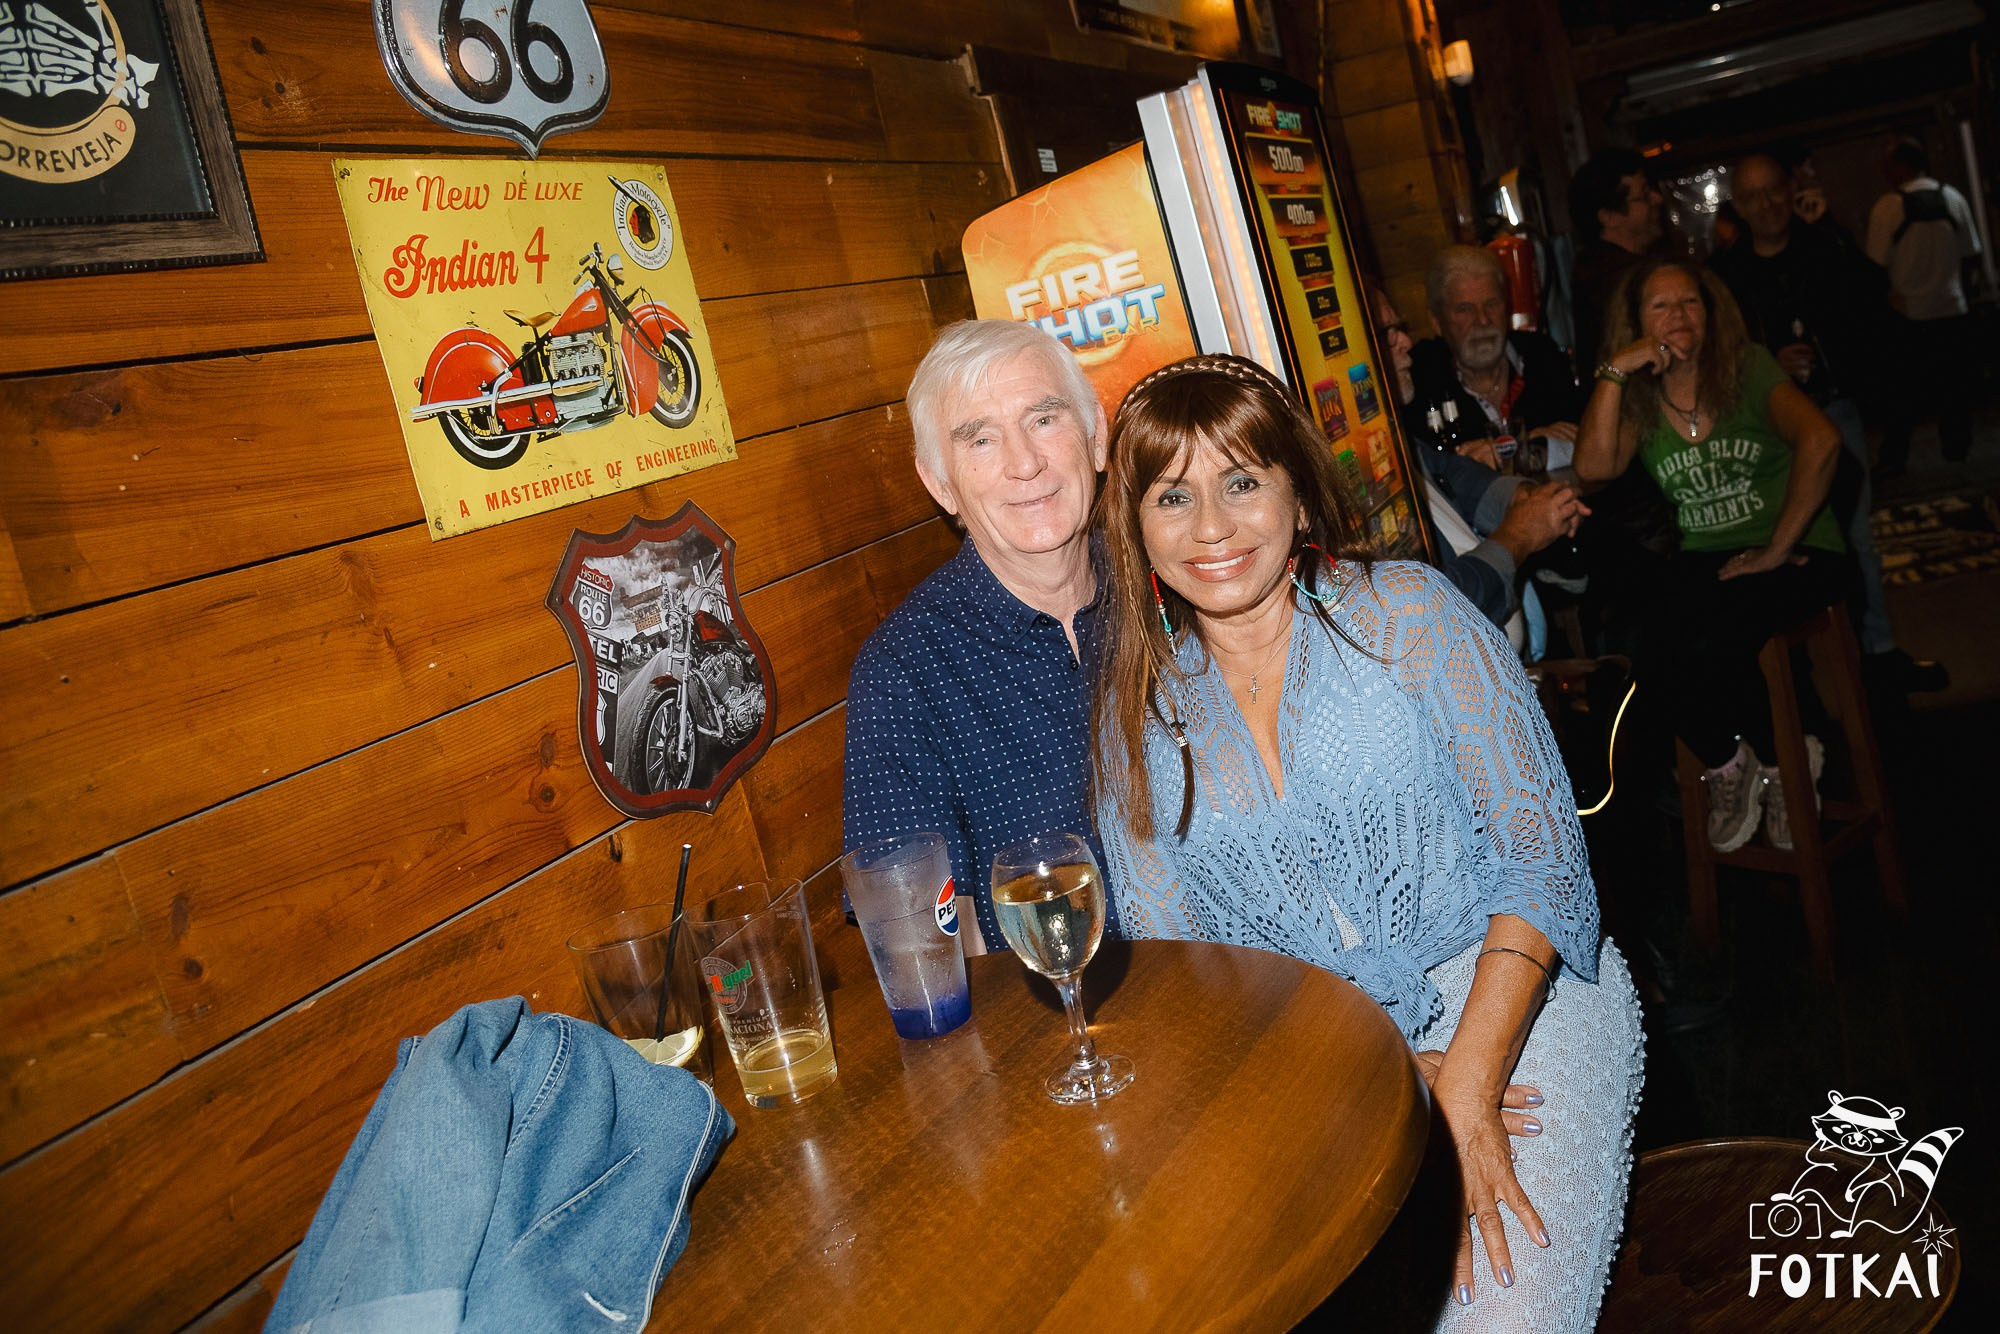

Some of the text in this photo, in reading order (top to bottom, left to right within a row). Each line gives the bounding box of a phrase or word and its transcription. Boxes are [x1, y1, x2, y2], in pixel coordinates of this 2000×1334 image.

[438, 0, 574, 104] 66
[1246, 104, 1302, 129] FIRE SHOT
[0, 131, 122, 173] ORREVIEJA
[368, 175, 583, 211] The New DE LUXE
[384, 226, 550, 299] Indian 4
[1005, 250, 1146, 321] FIRE
[1030, 283, 1166, 347] HOT
[1102, 317, 1160, 346] BAR
[1708, 438, 1763, 463] BLUE
[459, 438, 718, 518] A MASTERPIECE OF ENGINEERING
[580, 568, 610, 591] HISTORIC
[580, 585, 608, 603] ROUTE
[578, 596, 606, 626] 66
[590, 636, 619, 663] TEL
[937, 898, 957, 921] PEP
